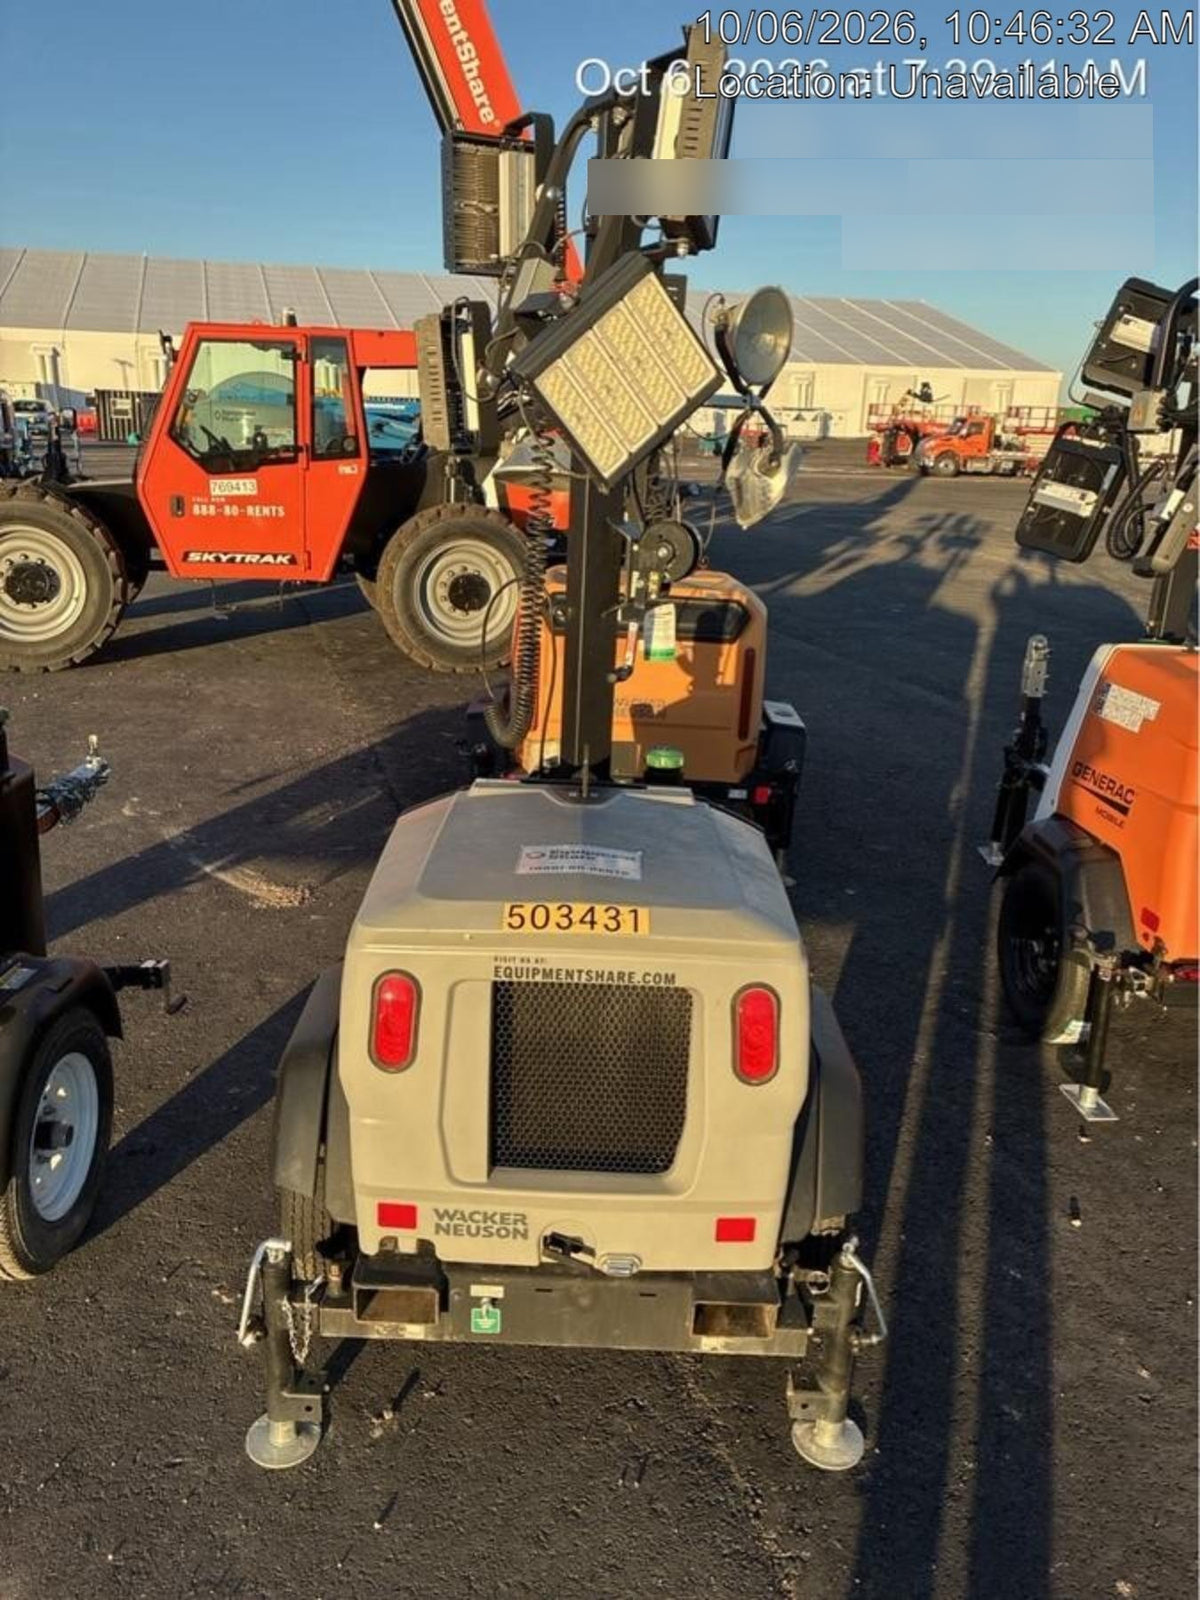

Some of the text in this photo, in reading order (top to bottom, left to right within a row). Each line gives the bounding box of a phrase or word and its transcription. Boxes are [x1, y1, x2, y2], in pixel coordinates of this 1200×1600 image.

[211, 480, 256, 494] 769413
[187, 551, 292, 565] SKYTRAK
[1071, 760, 1136, 805] GENERAC
[507, 903, 640, 933] 503431
[493, 965, 677, 986] EQUIPMENTSHARE.COM
[433, 1208, 528, 1226] WACKER
[435, 1223, 528, 1240] NEUSON
